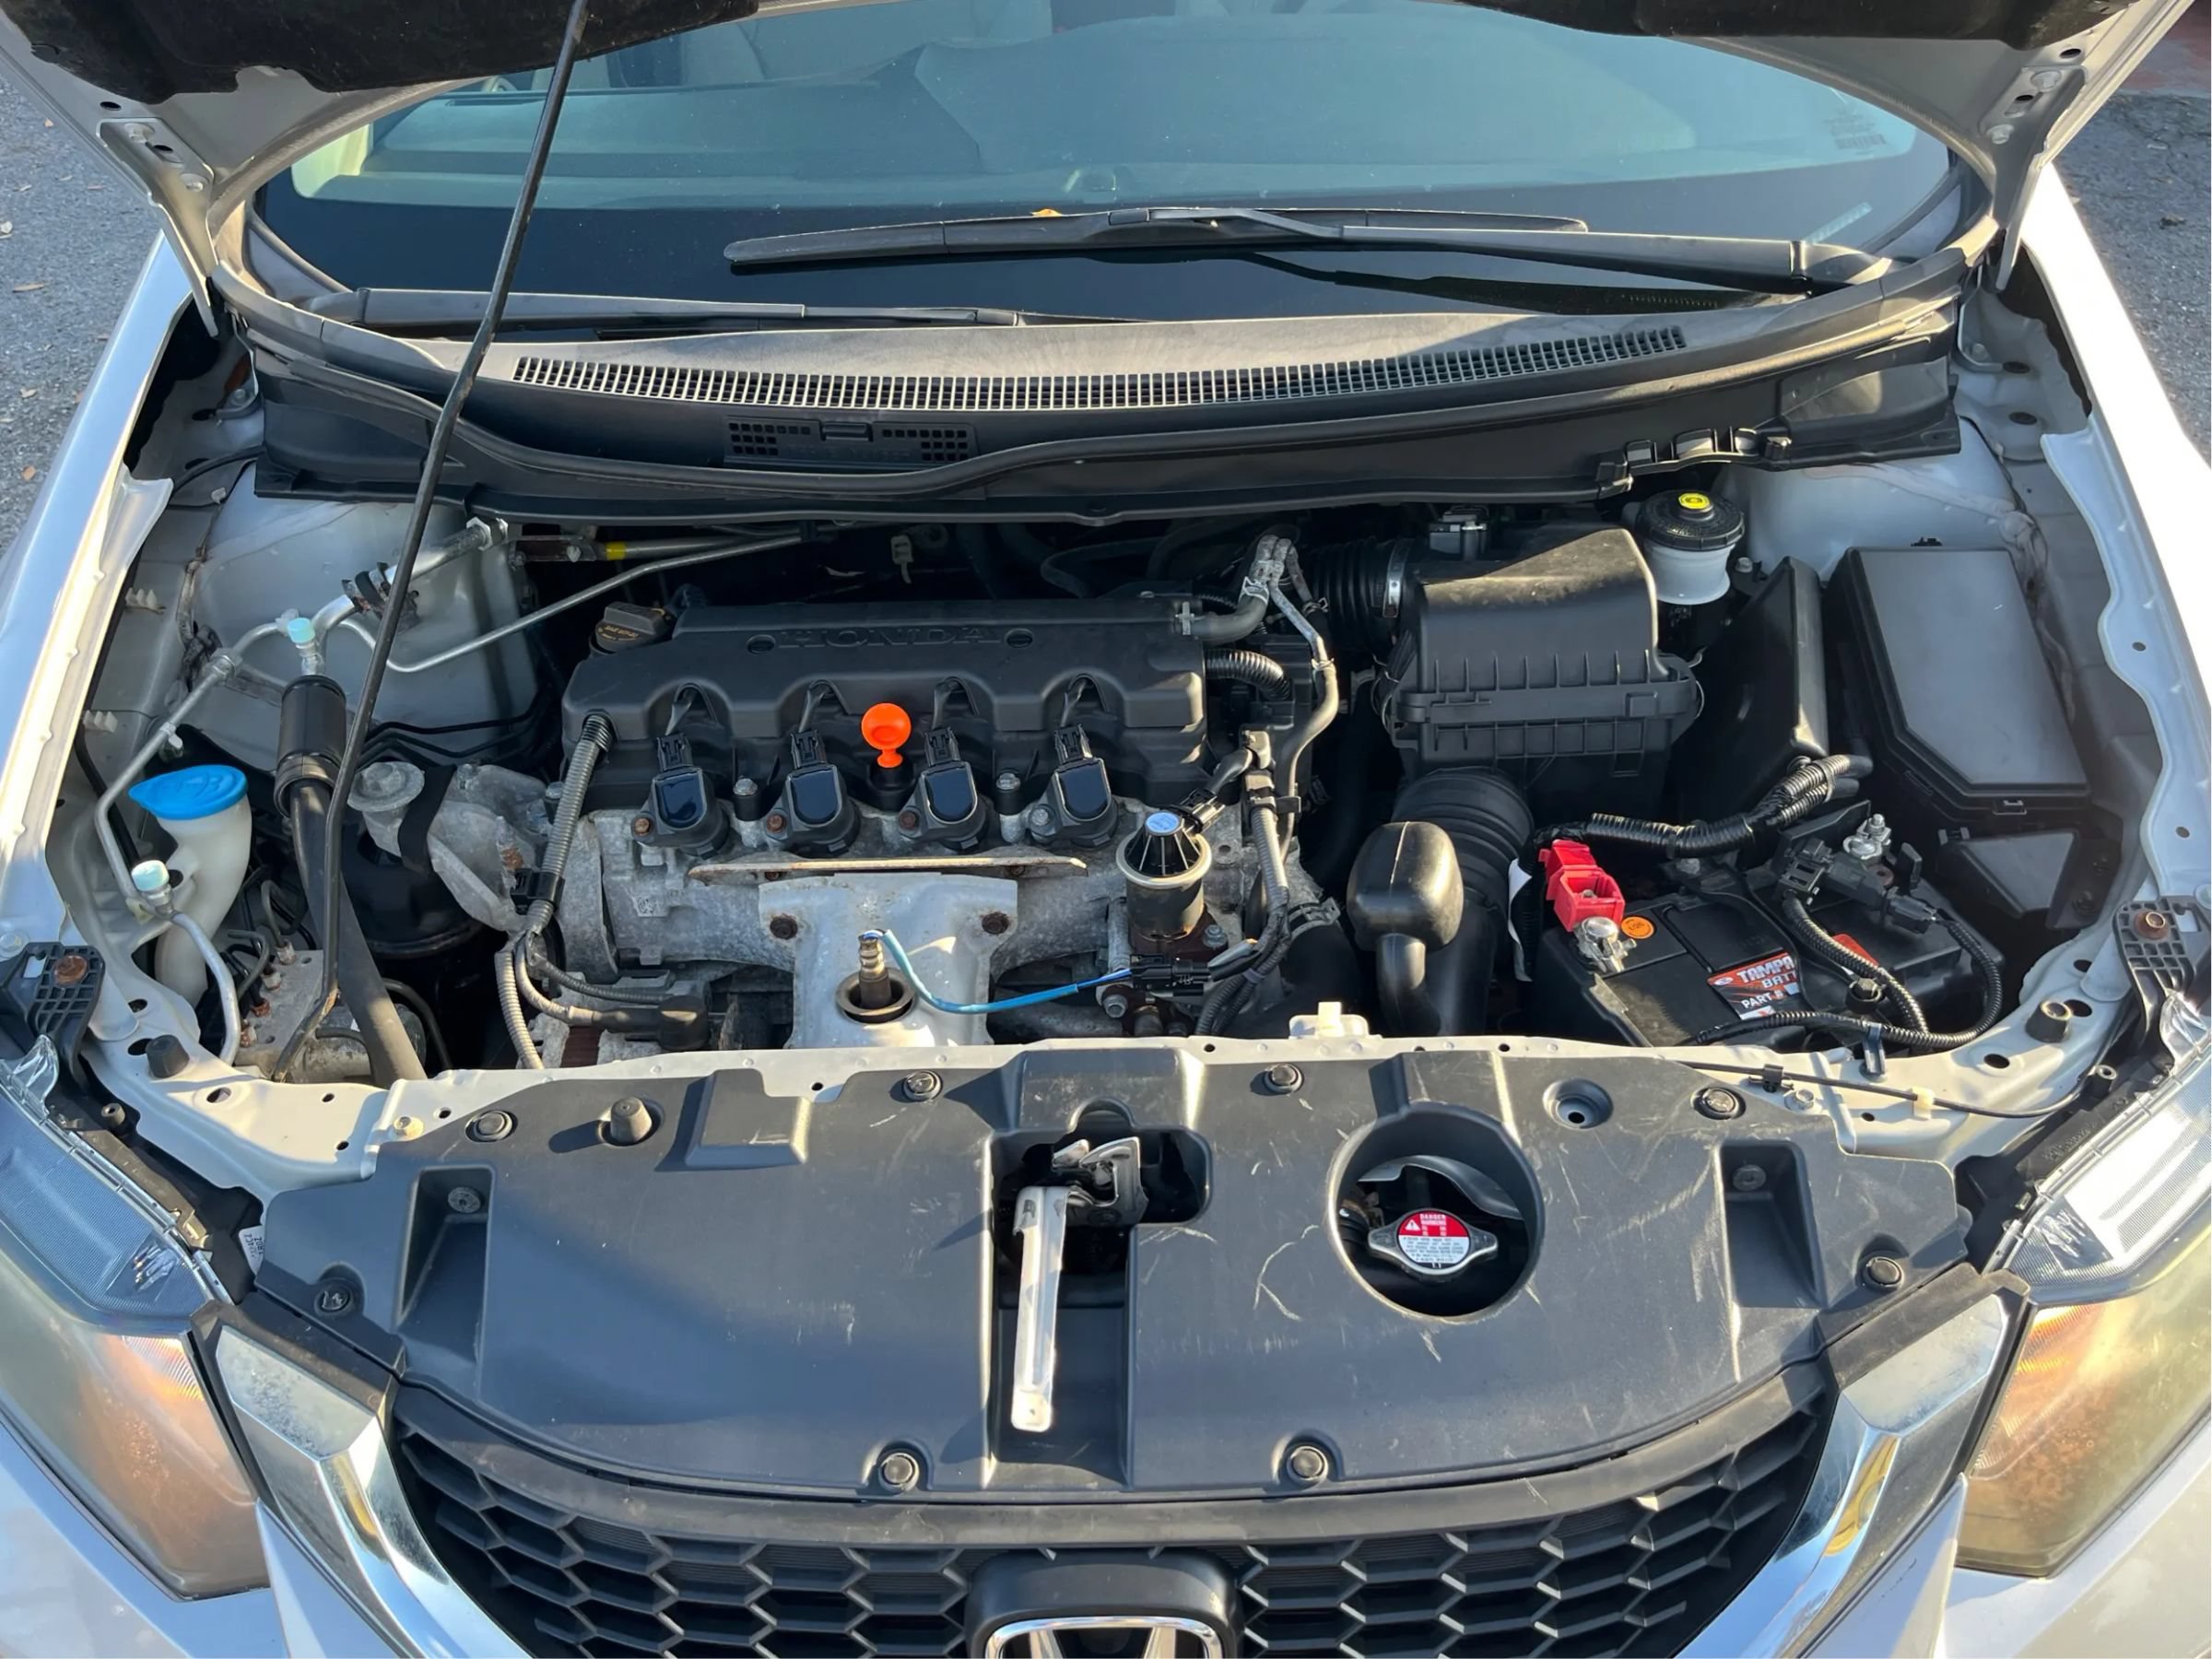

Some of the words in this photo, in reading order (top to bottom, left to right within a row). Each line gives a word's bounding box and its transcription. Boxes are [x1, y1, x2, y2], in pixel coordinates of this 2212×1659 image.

[779, 627, 1002, 648] HONDA
[1736, 956, 1795, 983] TAMPA
[1741, 993, 1772, 1009] PART
